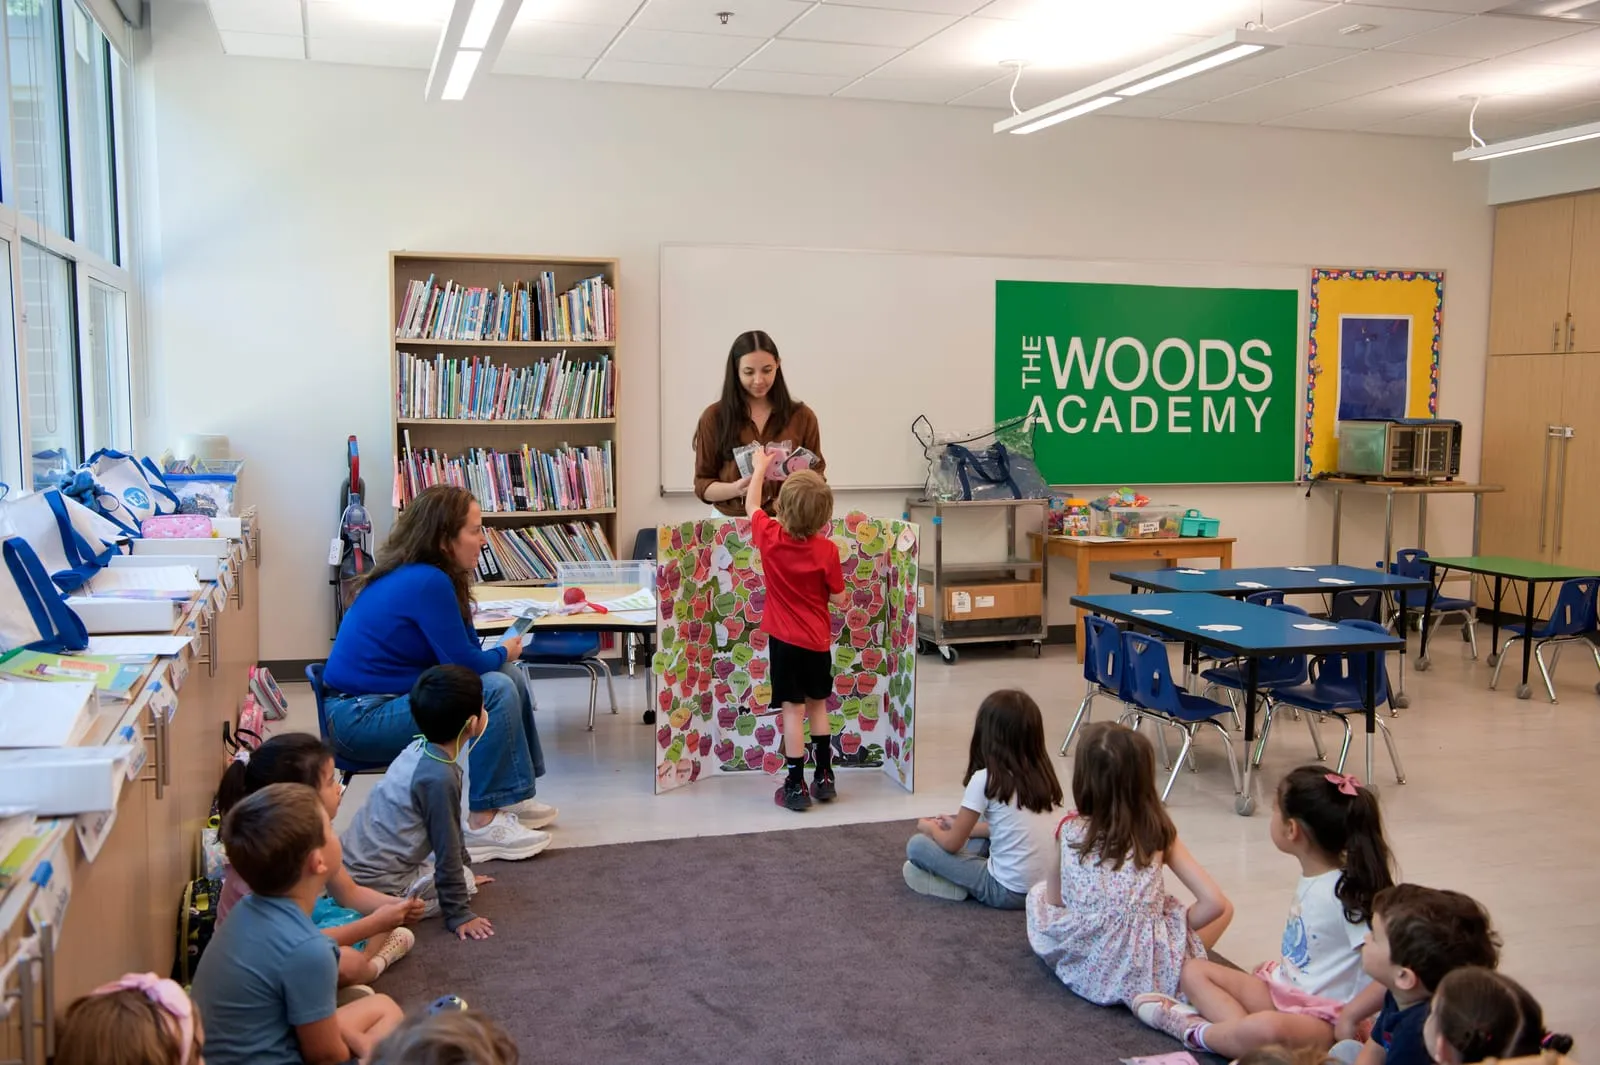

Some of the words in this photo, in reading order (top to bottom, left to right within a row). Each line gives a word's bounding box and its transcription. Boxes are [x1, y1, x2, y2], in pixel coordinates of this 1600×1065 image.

[1022, 336, 1041, 389] THE
[1046, 336, 1273, 392] WOODS
[1022, 395, 1272, 433] ACADEMY
